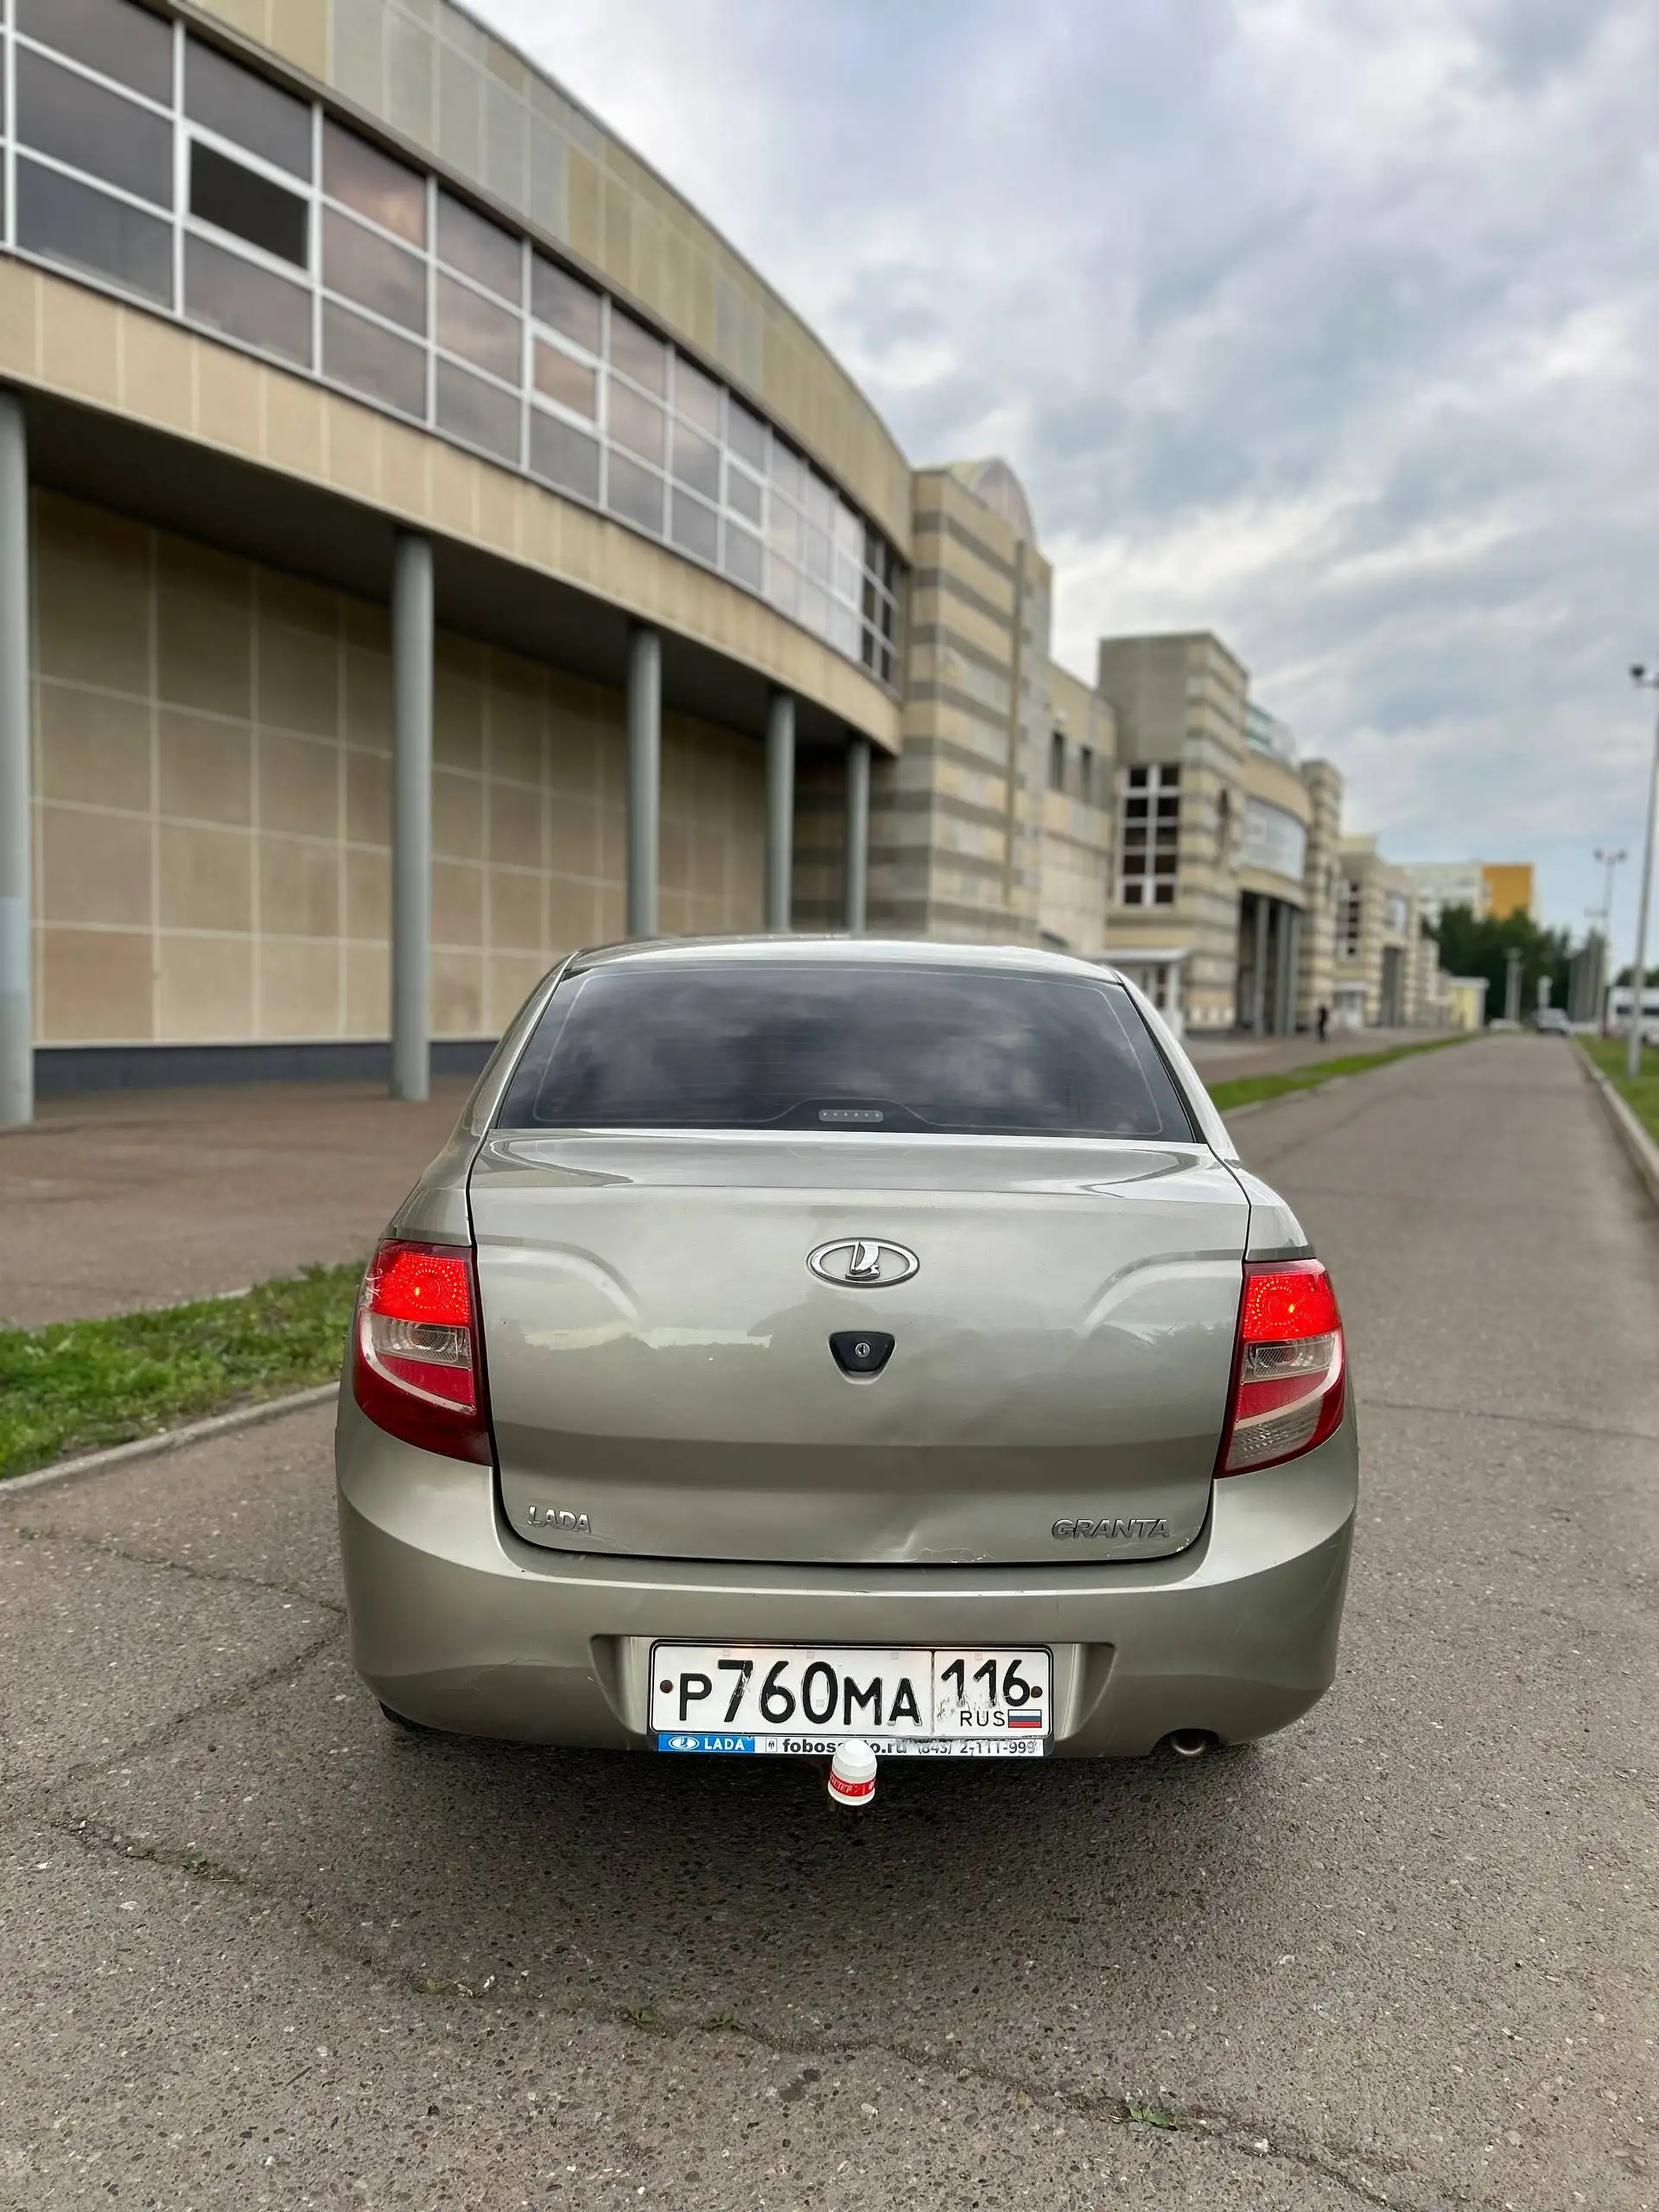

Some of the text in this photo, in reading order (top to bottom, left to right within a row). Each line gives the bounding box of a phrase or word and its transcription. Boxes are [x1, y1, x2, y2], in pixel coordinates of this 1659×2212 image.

[528, 1505, 591, 1533] LADA
[1052, 1518, 1171, 1540] GRANTA
[941, 1658, 1031, 1707] 116
[960, 1710, 1006, 1727] RUS
[704, 1737, 745, 1751] LADA
[782, 1738, 907, 1754] foboso.ru
